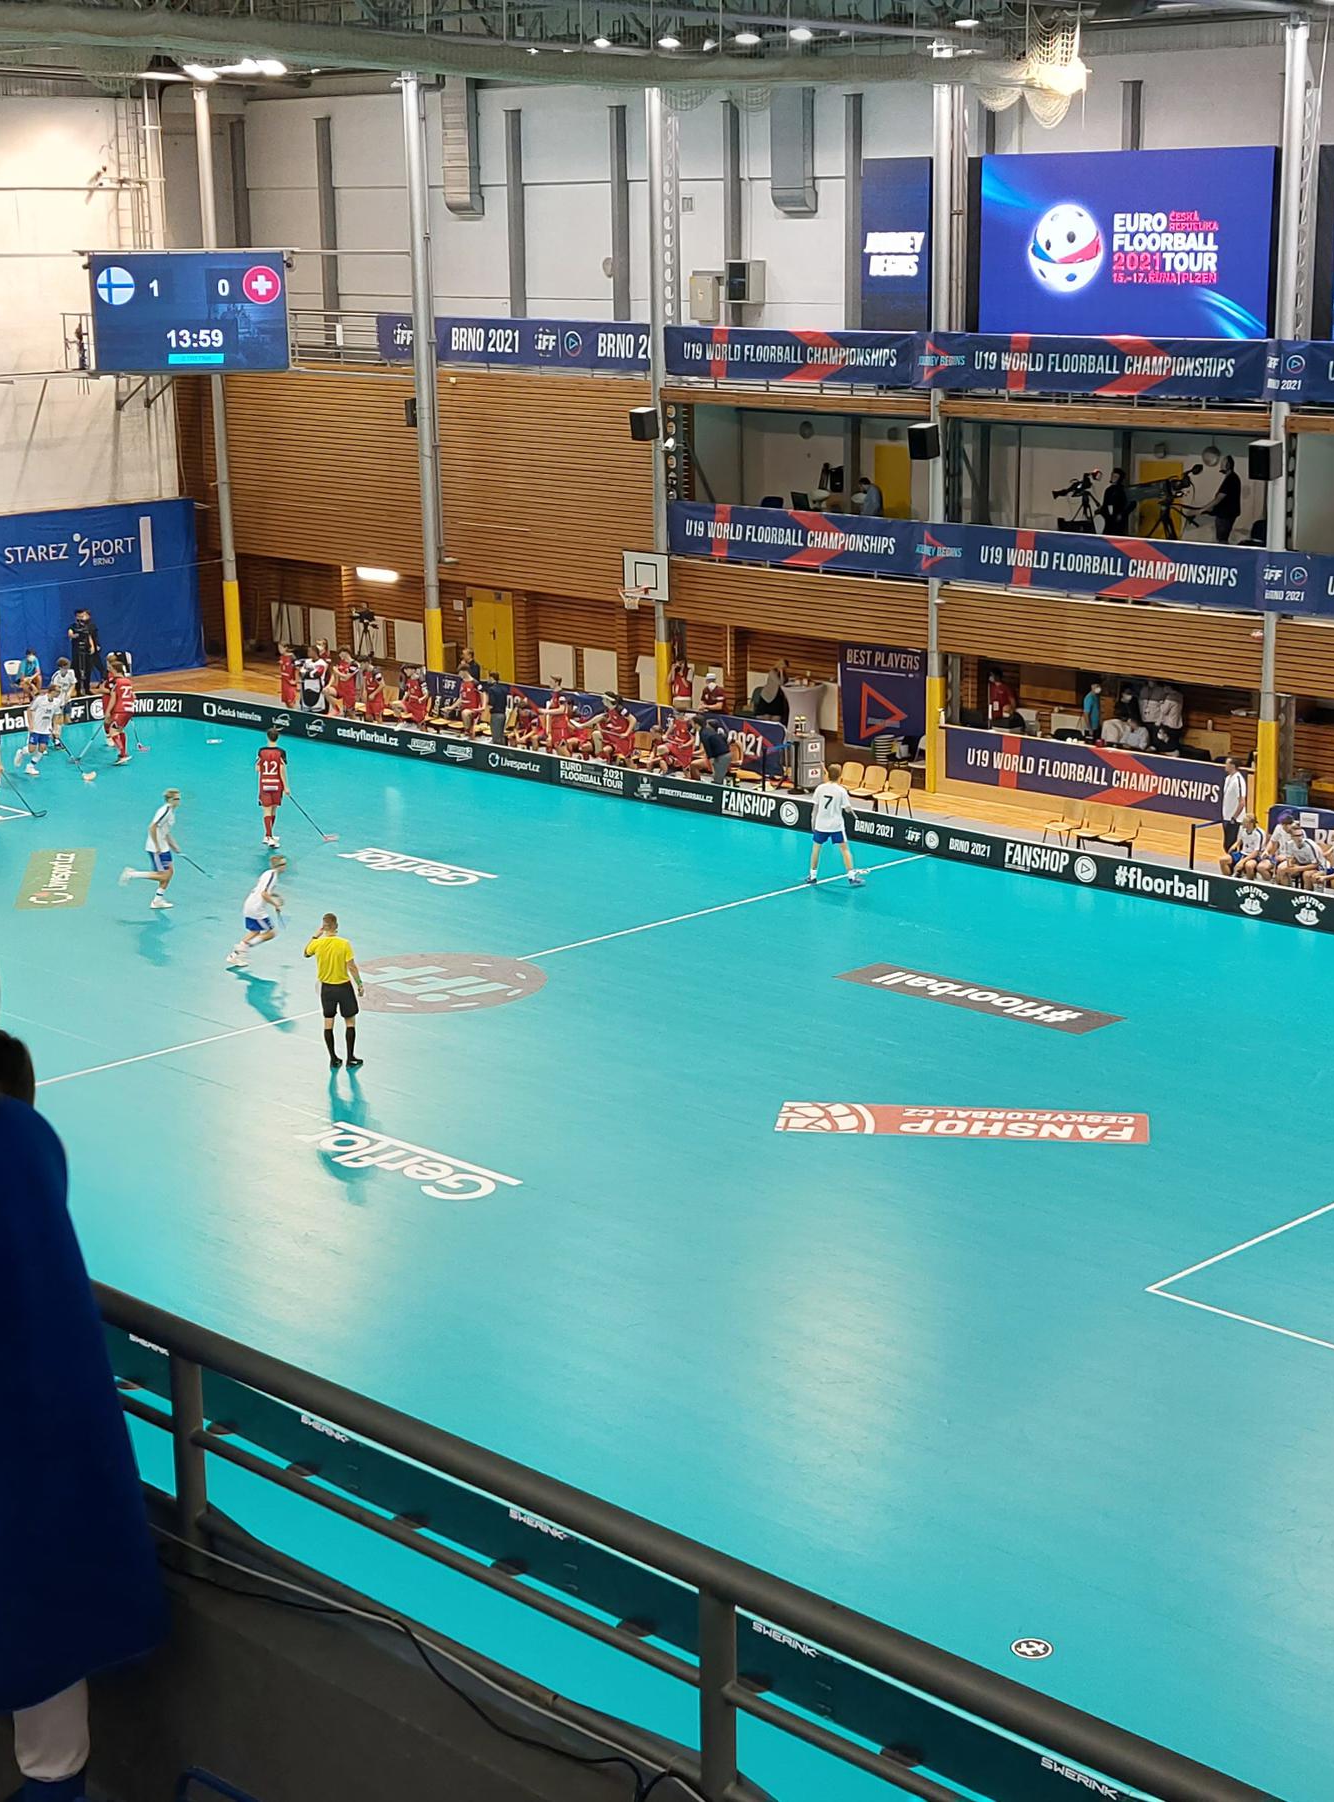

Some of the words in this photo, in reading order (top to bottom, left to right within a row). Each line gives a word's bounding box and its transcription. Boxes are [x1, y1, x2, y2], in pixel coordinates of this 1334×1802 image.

[1113, 212, 1167, 232] EURO
[1113, 232, 1219, 251] FLOORBALL
[1113, 252, 1161, 271] 2021
[1162, 252, 1218, 272] TOUR
[149, 279, 159, 297] 1
[218, 279, 229, 296] 0
[166, 329, 224, 348] 13:59
[452, 326, 484, 351] BRNO
[487, 328, 519, 353] 2021
[598, 333, 634, 359] BRNO
[683, 342, 702, 361] U19
[706, 342, 740, 362] WORLD
[744, 344, 803, 365] FLOORBALL
[806, 345, 897, 367] CHAMPIONSHIPS
[974, 350, 997, 371] U19
[1001, 351, 1043, 373] WORLD
[1047, 353, 1119, 376] FLOORBALL
[1124, 355, 1236, 378] CHAMPIONSHIPS
[1280, 379, 1302, 391] 2021
[684, 519, 704, 537] U19
[707, 521, 743, 541] WORLD
[745, 524, 805, 548] FLOORBALL
[806, 530, 897, 556] CHAMPIONSHIPS
[5, 543, 69, 565] STAREZ
[78, 537, 136, 567] SPORT
[93, 556, 115, 566] BRNO
[980, 544, 1003, 565] U19
[1006, 547, 1049, 571] WORLD
[1052, 550, 1125, 578] FLOORBALL
[1127, 556, 1237, 587] CHAMPIONSHIPS
[1285, 590, 1305, 602] 2021
[846, 648, 872, 668] BEST
[874, 651, 920, 672] PLAYERS
[156, 699, 183, 713] 2021
[262, 760, 278, 775] 12
[559, 760, 582, 772] EURO
[603, 768, 624, 781] 2021
[967, 746, 989, 768] U19
[992, 750, 1035, 775] WORLD
[1037, 758, 1108, 787] FLOORBALL
[1112, 769, 1220, 803] CHAMPIONSHIPS
[602, 777, 624, 790] TOUR
[721, 790, 776, 818] FANSHOP
[823, 795, 834, 810] 7
[875, 822, 894, 838] 2021
[970, 841, 991, 858] 2021
[1004, 842, 1070, 874] FANSHOP
[338, 848, 498, 887] Gerflor
[1114, 865, 1209, 902] #floorball
[871, 971, 1083, 1024] #floorball
[903, 1108, 1136, 1125] CESKYFLORBAL.CZ
[899, 1120, 1137, 1141] FANSHOP
[296, 1121, 524, 1201] Gerflor
[751, 1620, 820, 1659] SWERINK
[1040, 1755, 1118, 1801] SWERINK
